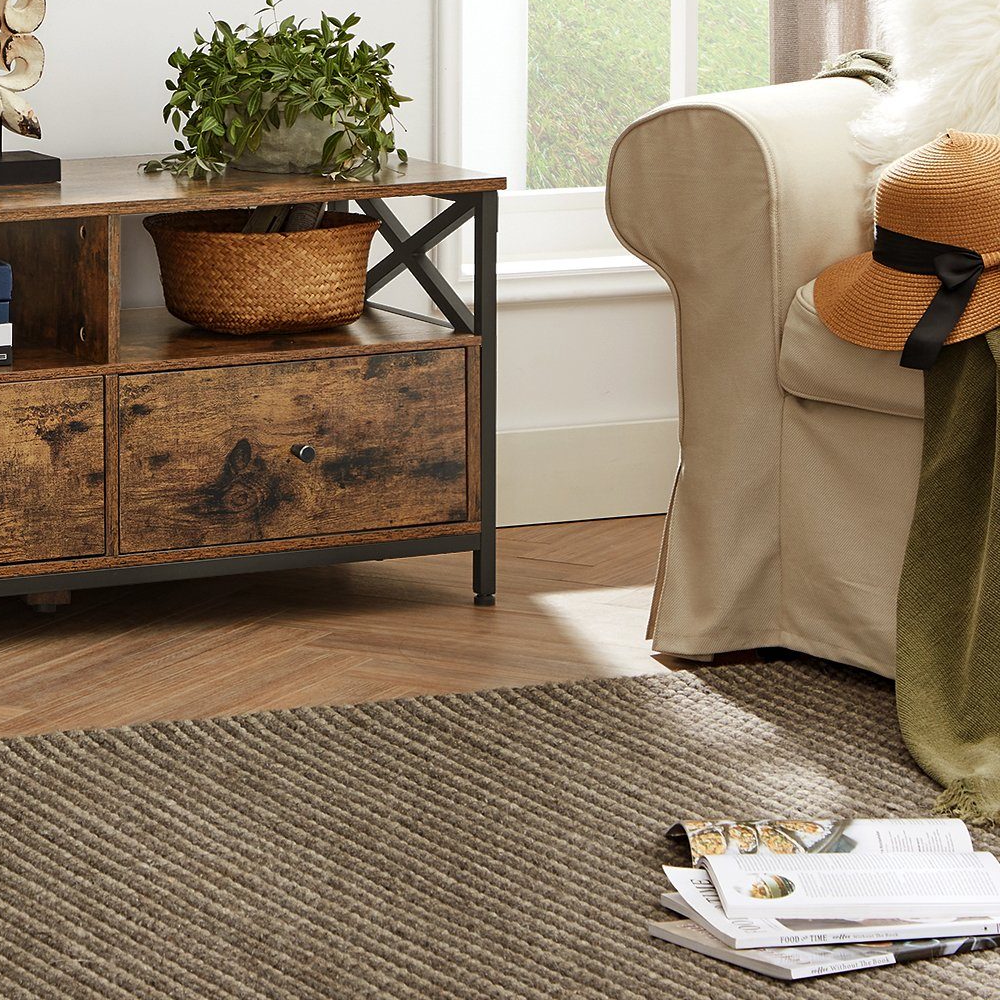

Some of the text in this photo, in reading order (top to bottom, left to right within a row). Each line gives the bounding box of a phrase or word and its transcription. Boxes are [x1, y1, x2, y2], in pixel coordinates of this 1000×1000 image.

[779, 935, 800, 944] FOOD
[810, 933, 828, 942] TIME
[830, 962, 859, 972] Without
[872, 957, 890, 965] Book
